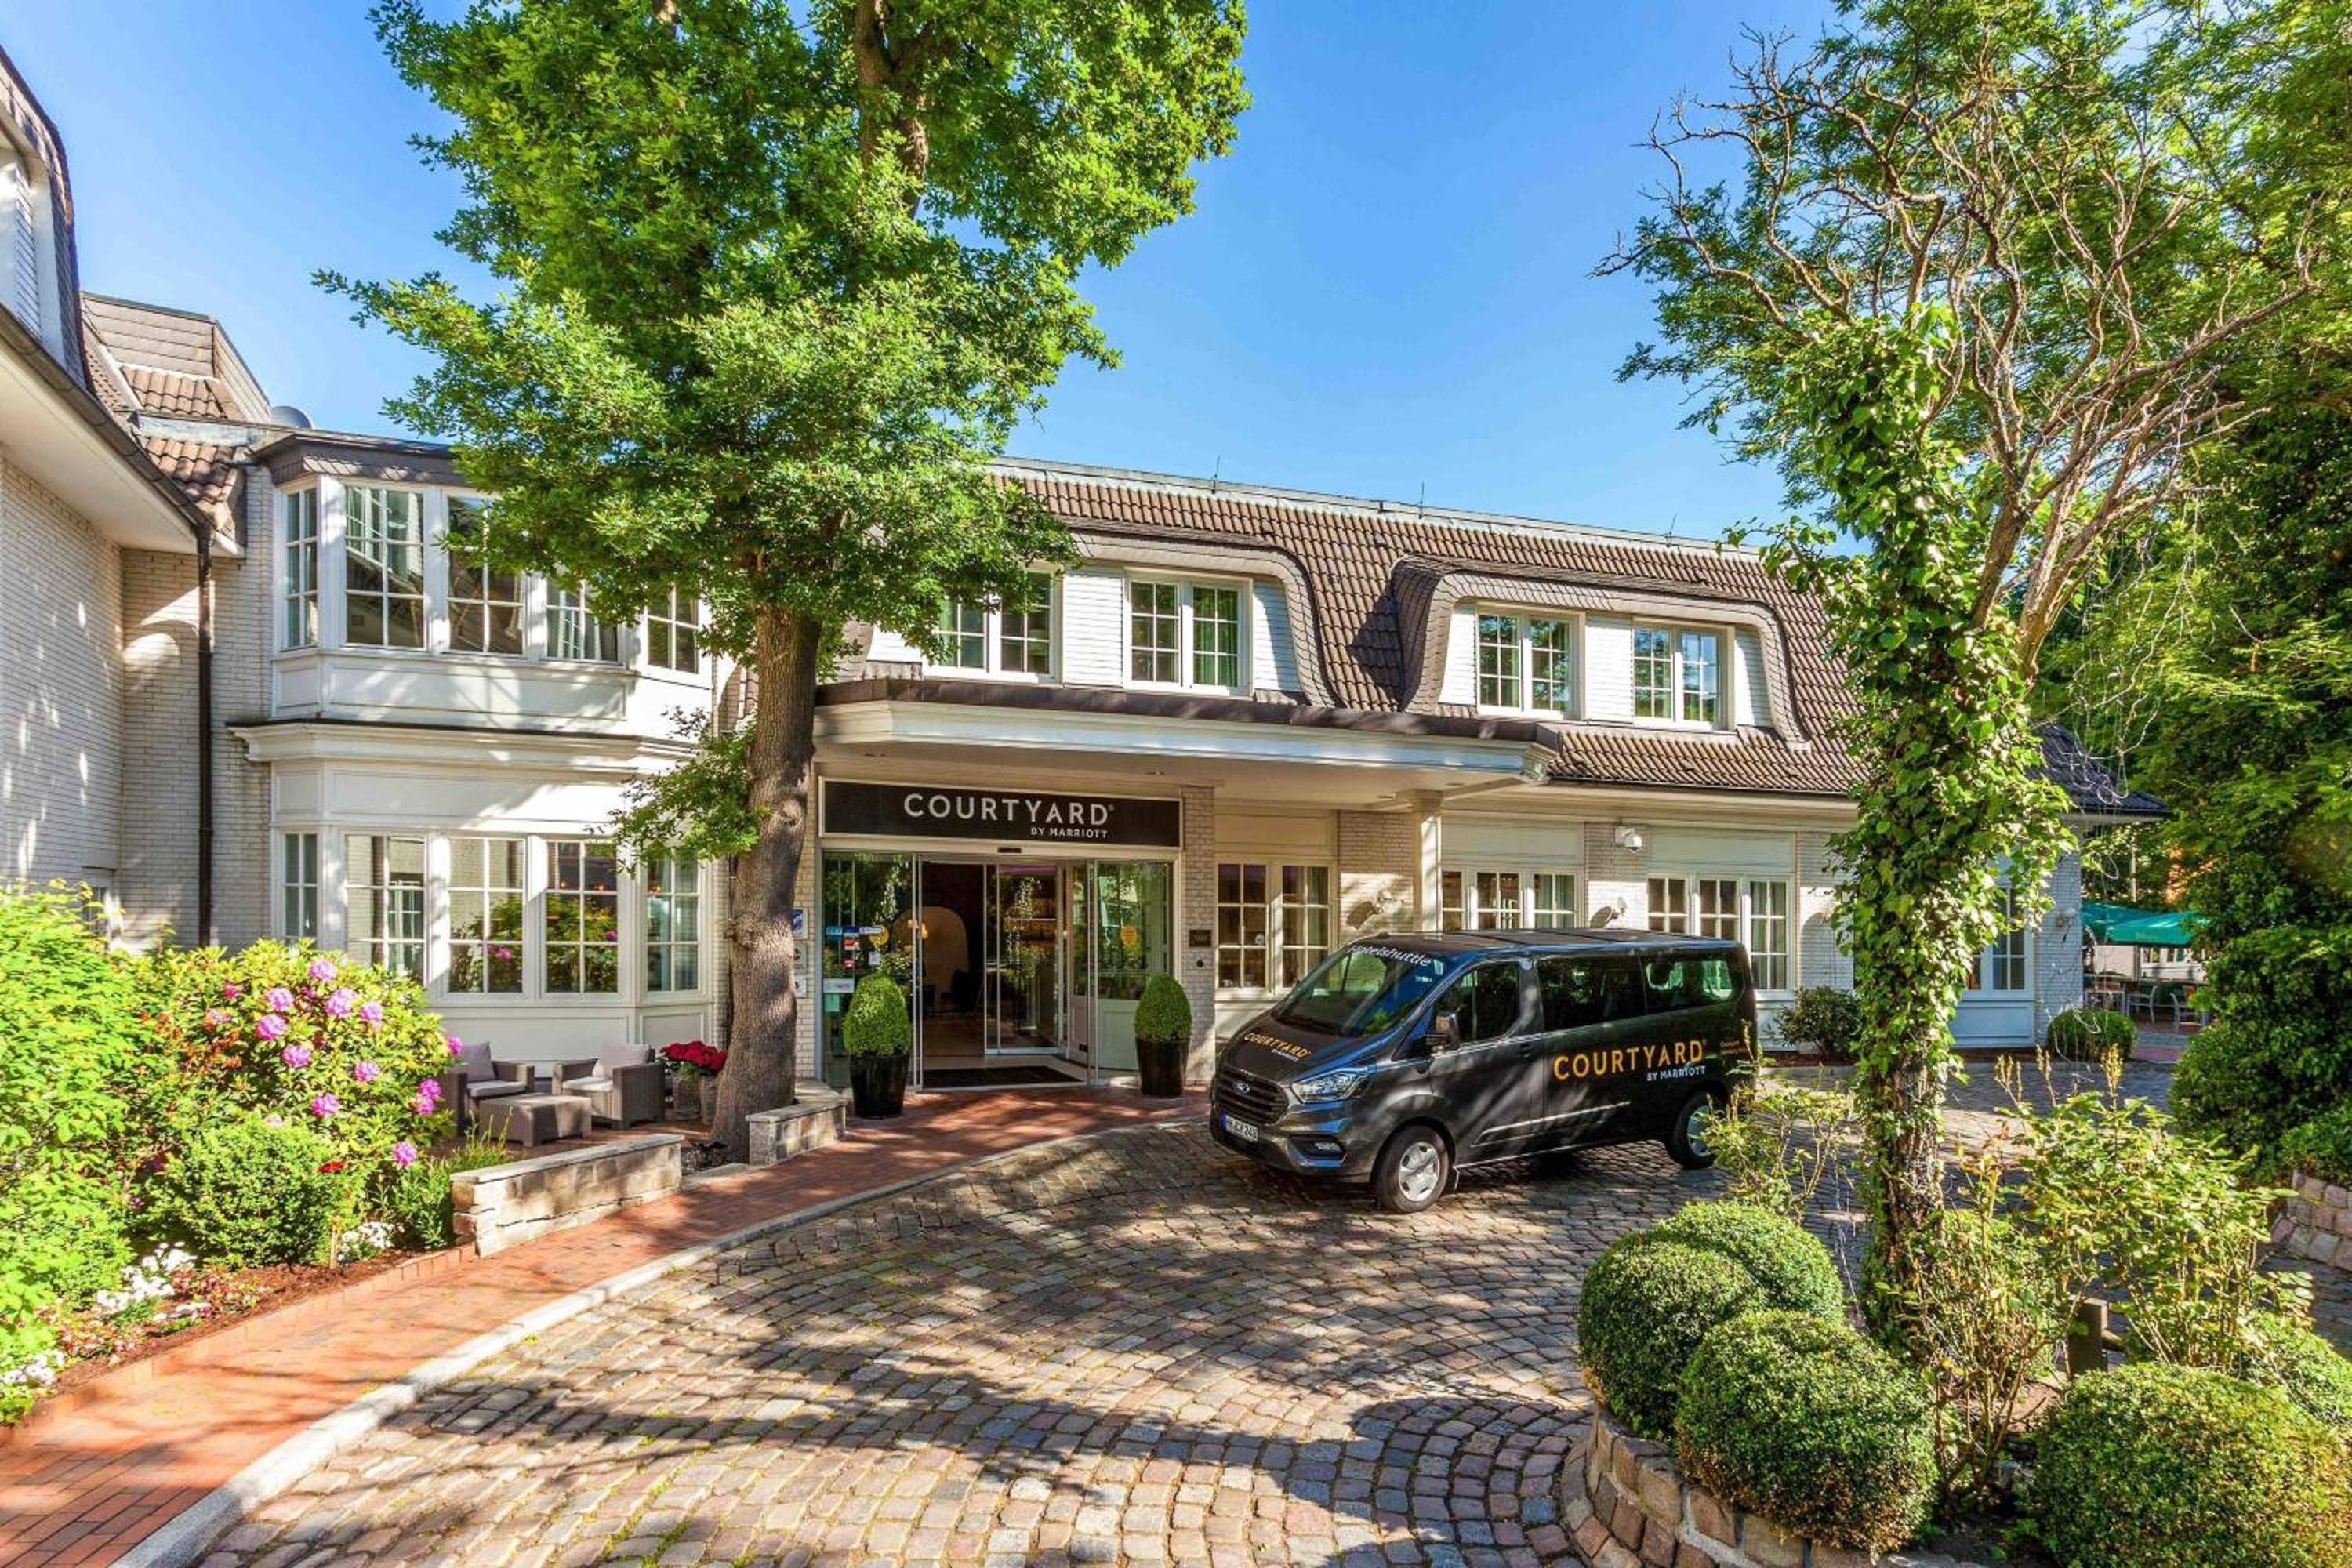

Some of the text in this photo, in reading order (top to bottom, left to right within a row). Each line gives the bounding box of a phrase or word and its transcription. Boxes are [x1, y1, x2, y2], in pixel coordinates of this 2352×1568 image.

[903, 793, 1109, 826] COURTYARD
[1030, 827, 1108, 839] BY MARRIOTT
[1244, 1033, 1308, 1058] COURTYARD
[1553, 1040, 1704, 1080] COURTYARD
[1646, 1065, 1706, 1081] BY MARRIOTT
